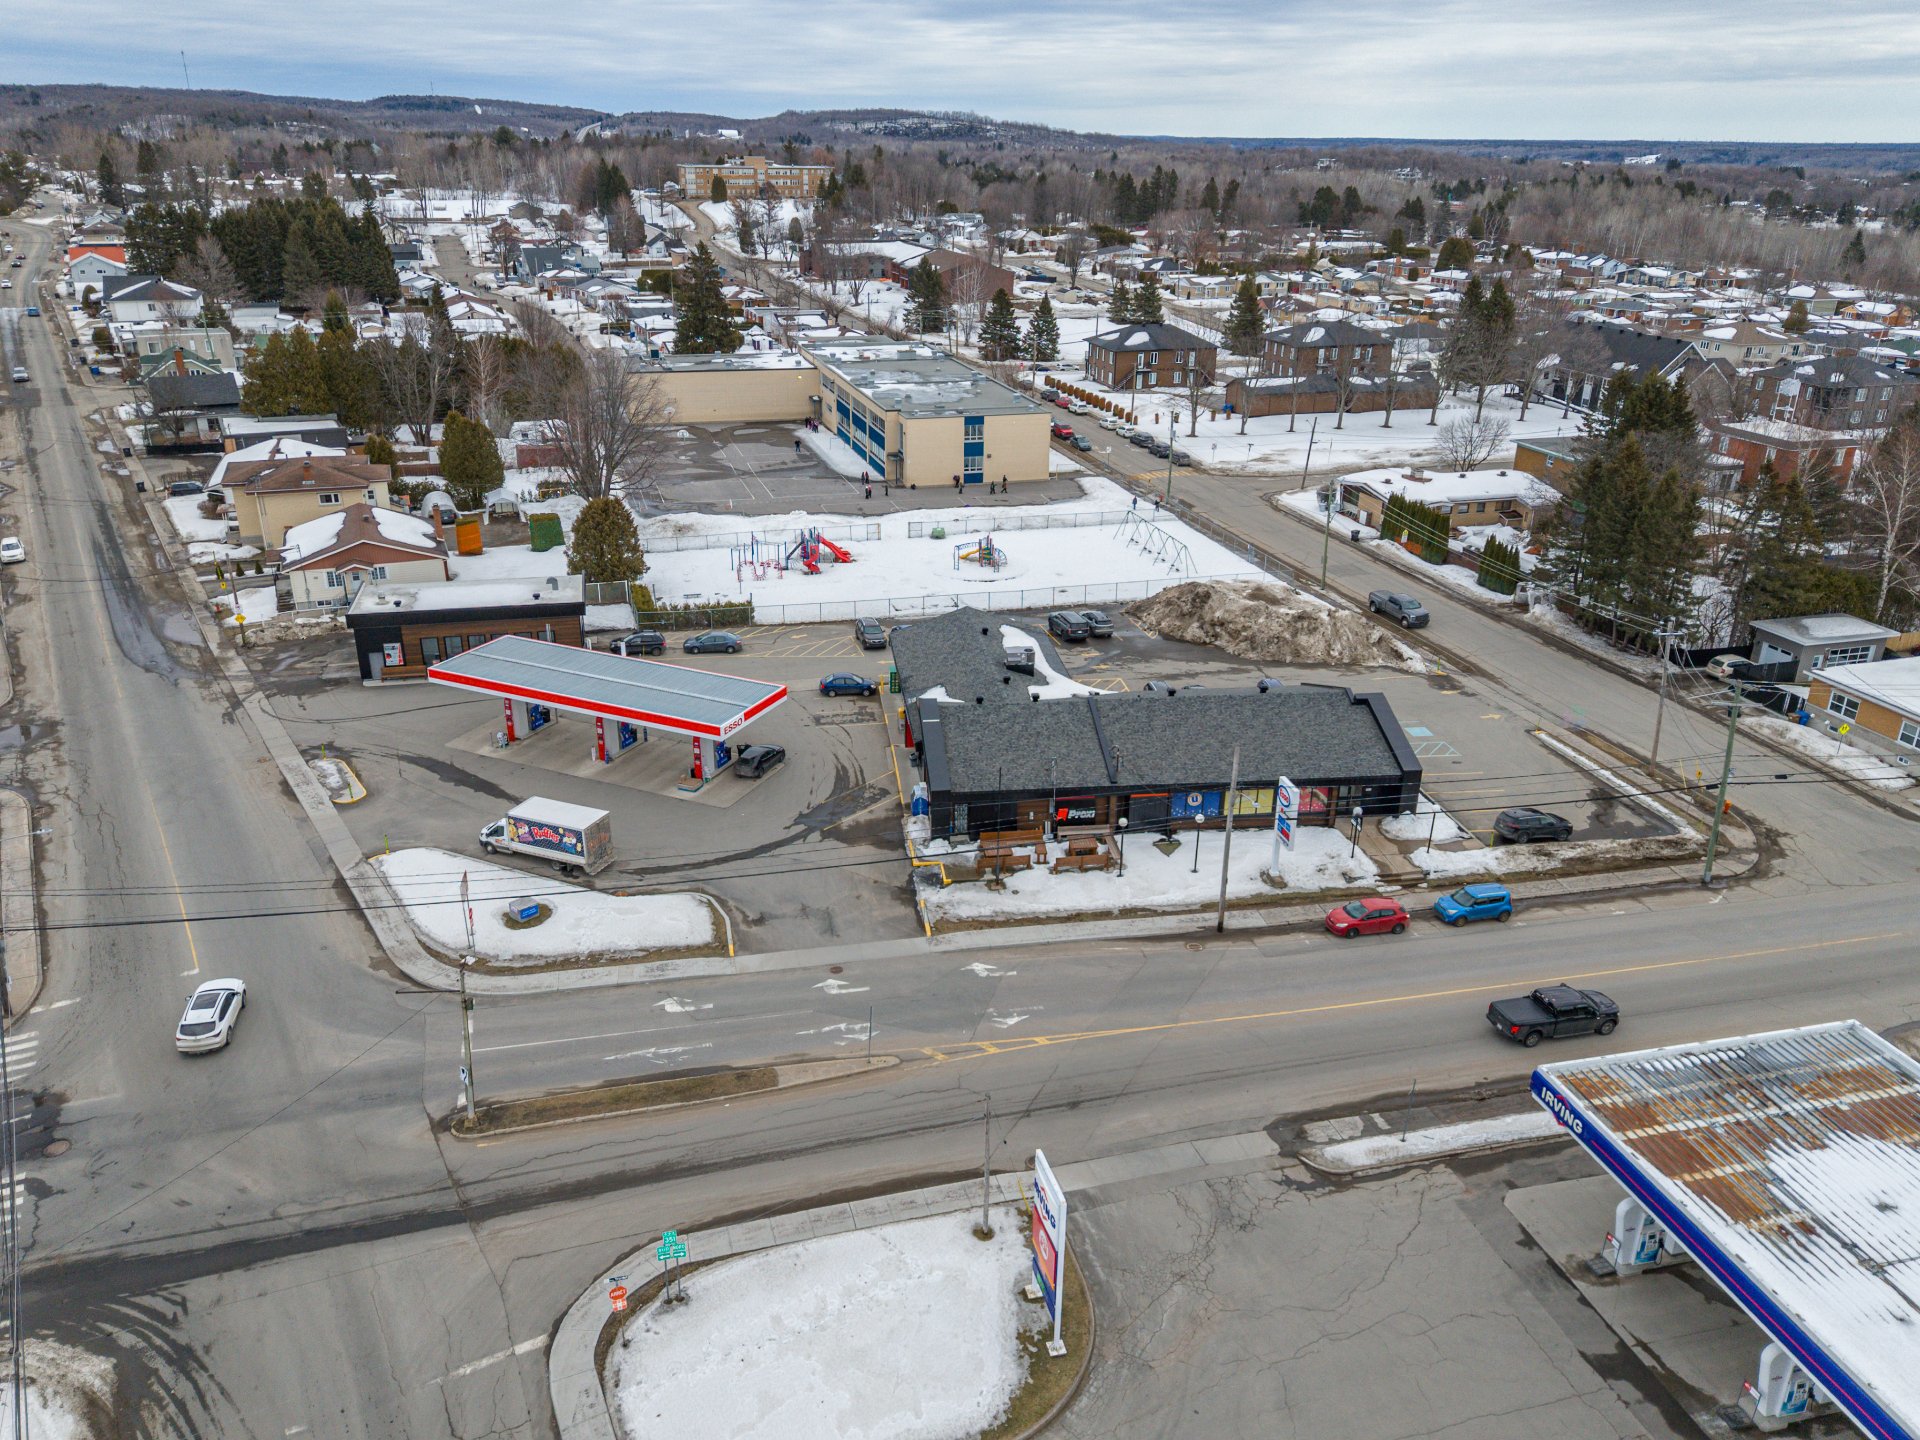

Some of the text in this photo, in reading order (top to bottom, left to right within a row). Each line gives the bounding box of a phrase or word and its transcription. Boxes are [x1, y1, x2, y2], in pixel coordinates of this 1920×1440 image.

[724, 718, 743, 735] ESSO
[531, 826, 560, 844] Ruffles
[1541, 1086, 1583, 1134] IRVING
[1034, 1177, 1056, 1230] IRVING
